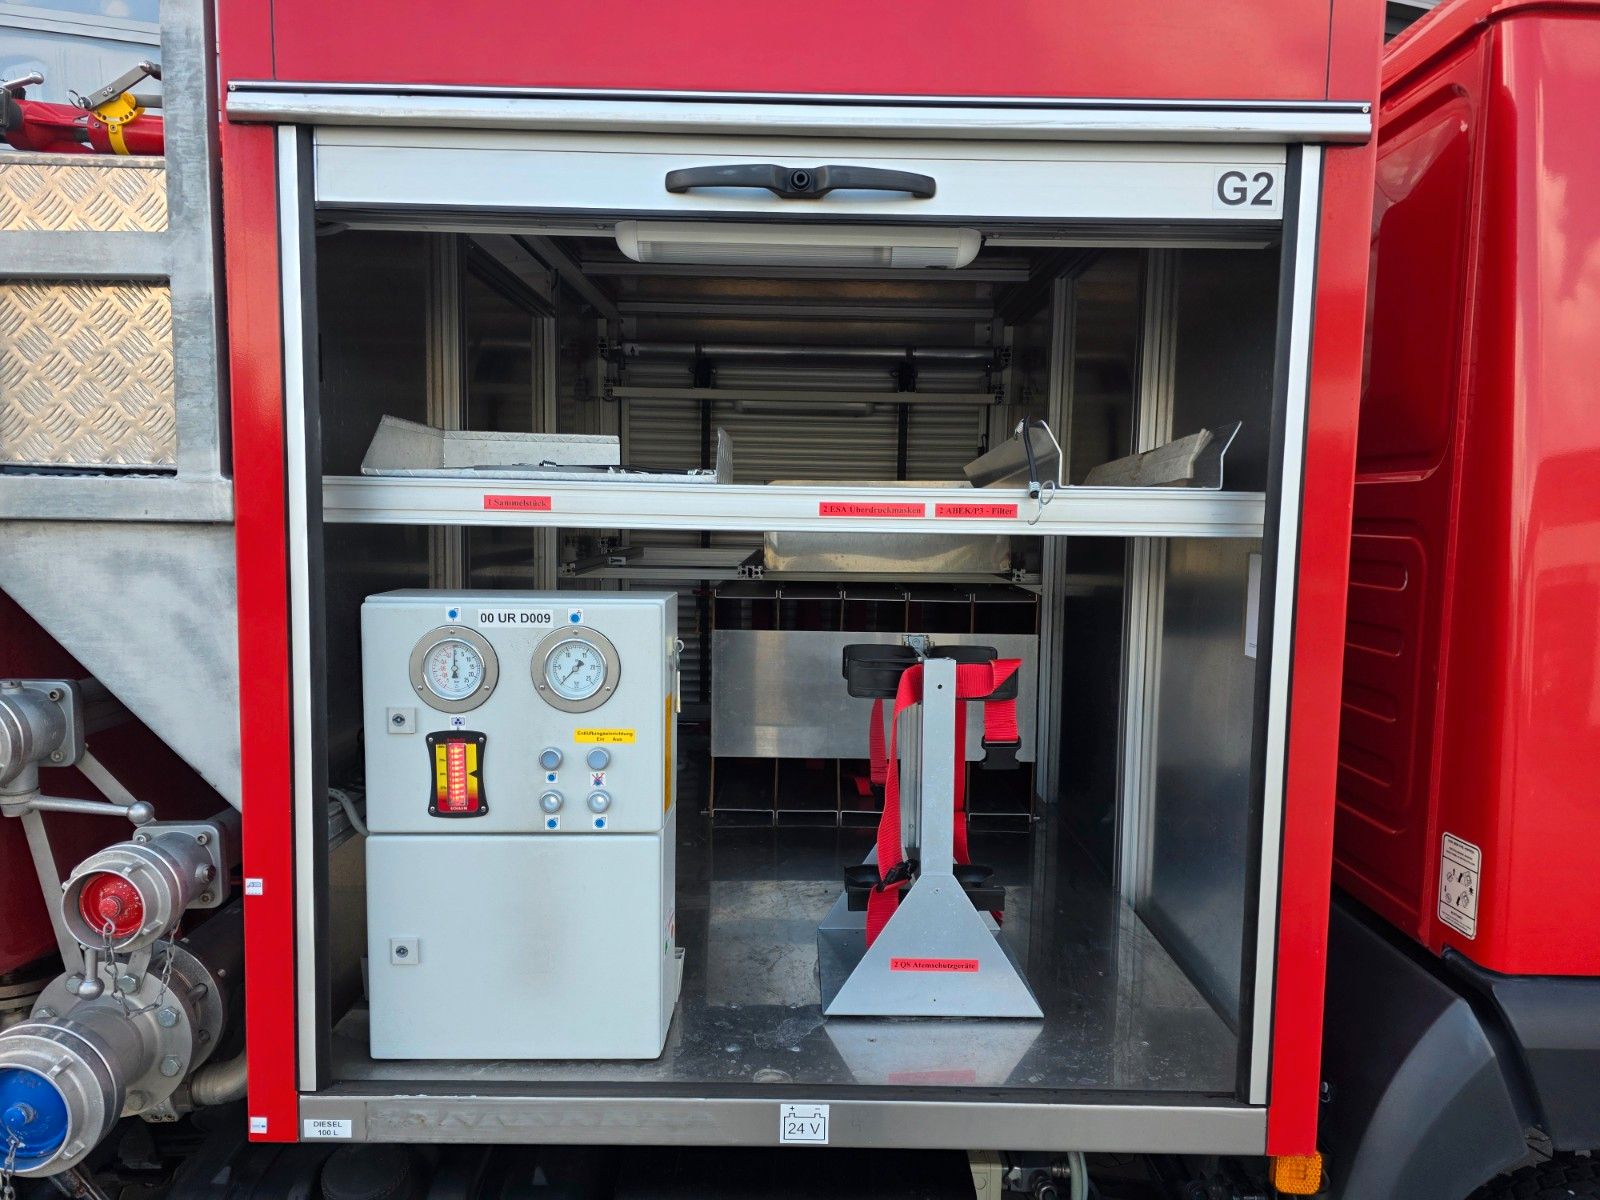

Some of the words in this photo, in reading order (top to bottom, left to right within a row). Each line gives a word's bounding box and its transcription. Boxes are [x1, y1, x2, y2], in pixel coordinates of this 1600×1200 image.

[1217, 171, 1274, 206] G2
[494, 499, 546, 507] Sammelstück
[830, 505, 847, 513] ESA
[946, 507, 984, 515] ABEK/P3
[992, 507, 1013, 515] Filter
[480, 613, 494, 623] 00
[498, 613, 516, 623] UR
[520, 613, 551, 623] D009
[900, 961, 911, 969] QS
[913, 961, 975, 970] Atemschutzgeräte
[788, 1122, 805, 1134] 24
[810, 1122, 820, 1134] V
